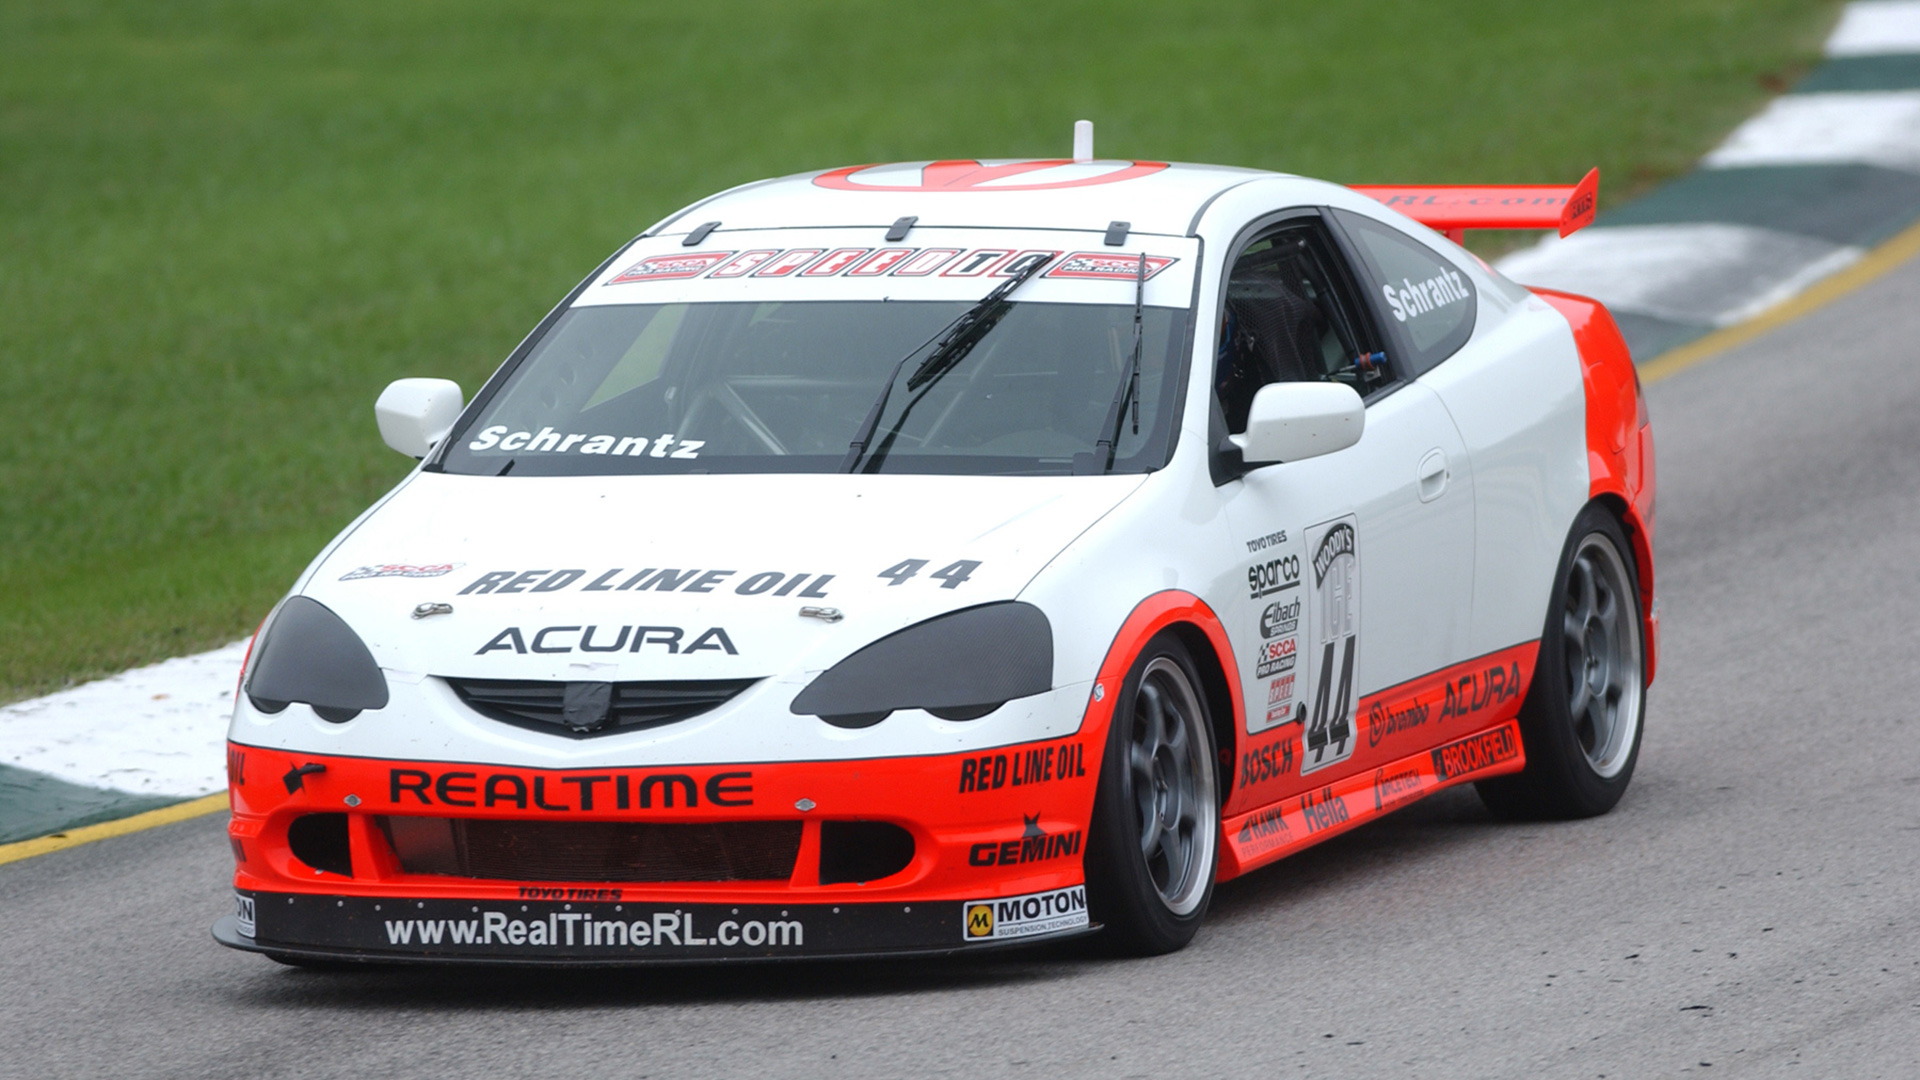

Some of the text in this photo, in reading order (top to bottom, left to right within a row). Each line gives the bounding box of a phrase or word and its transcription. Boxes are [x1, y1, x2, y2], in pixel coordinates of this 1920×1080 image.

[1383, 266, 1470, 322] Schrantz
[468, 425, 706, 459] Schrantz
[1246, 530, 1288, 553] TOYO TIRES
[456, 568, 836, 598] RED LINE OIL
[876, 558, 983, 589] 44
[1248, 554, 1300, 599] sparco
[1260, 596, 1300, 638] Eibach
[473, 625, 739, 655] ACURA
[1269, 638, 1296, 659] SCCA
[1307, 634, 1356, 763] 44
[1438, 661, 1520, 723] ACURA
[1386, 697, 1429, 736] brembo
[959, 743, 1086, 794] RED LINE OIL
[1239, 738, 1293, 790] BOSCH
[1441, 728, 1517, 779] BROOKFIELD
[389, 769, 754, 811] REALTIME
[1250, 805, 1289, 840] HAWK
[1301, 786, 1350, 834] Hella
[968, 830, 1082, 867] GEMINI
[519, 887, 623, 900] TOYO TIRES
[998, 888, 1086, 923] MOTON
[385, 911, 803, 947] www.RealTimeRL.com
[998, 914, 1088, 936] SUSPENSION TECHNOLOGY
